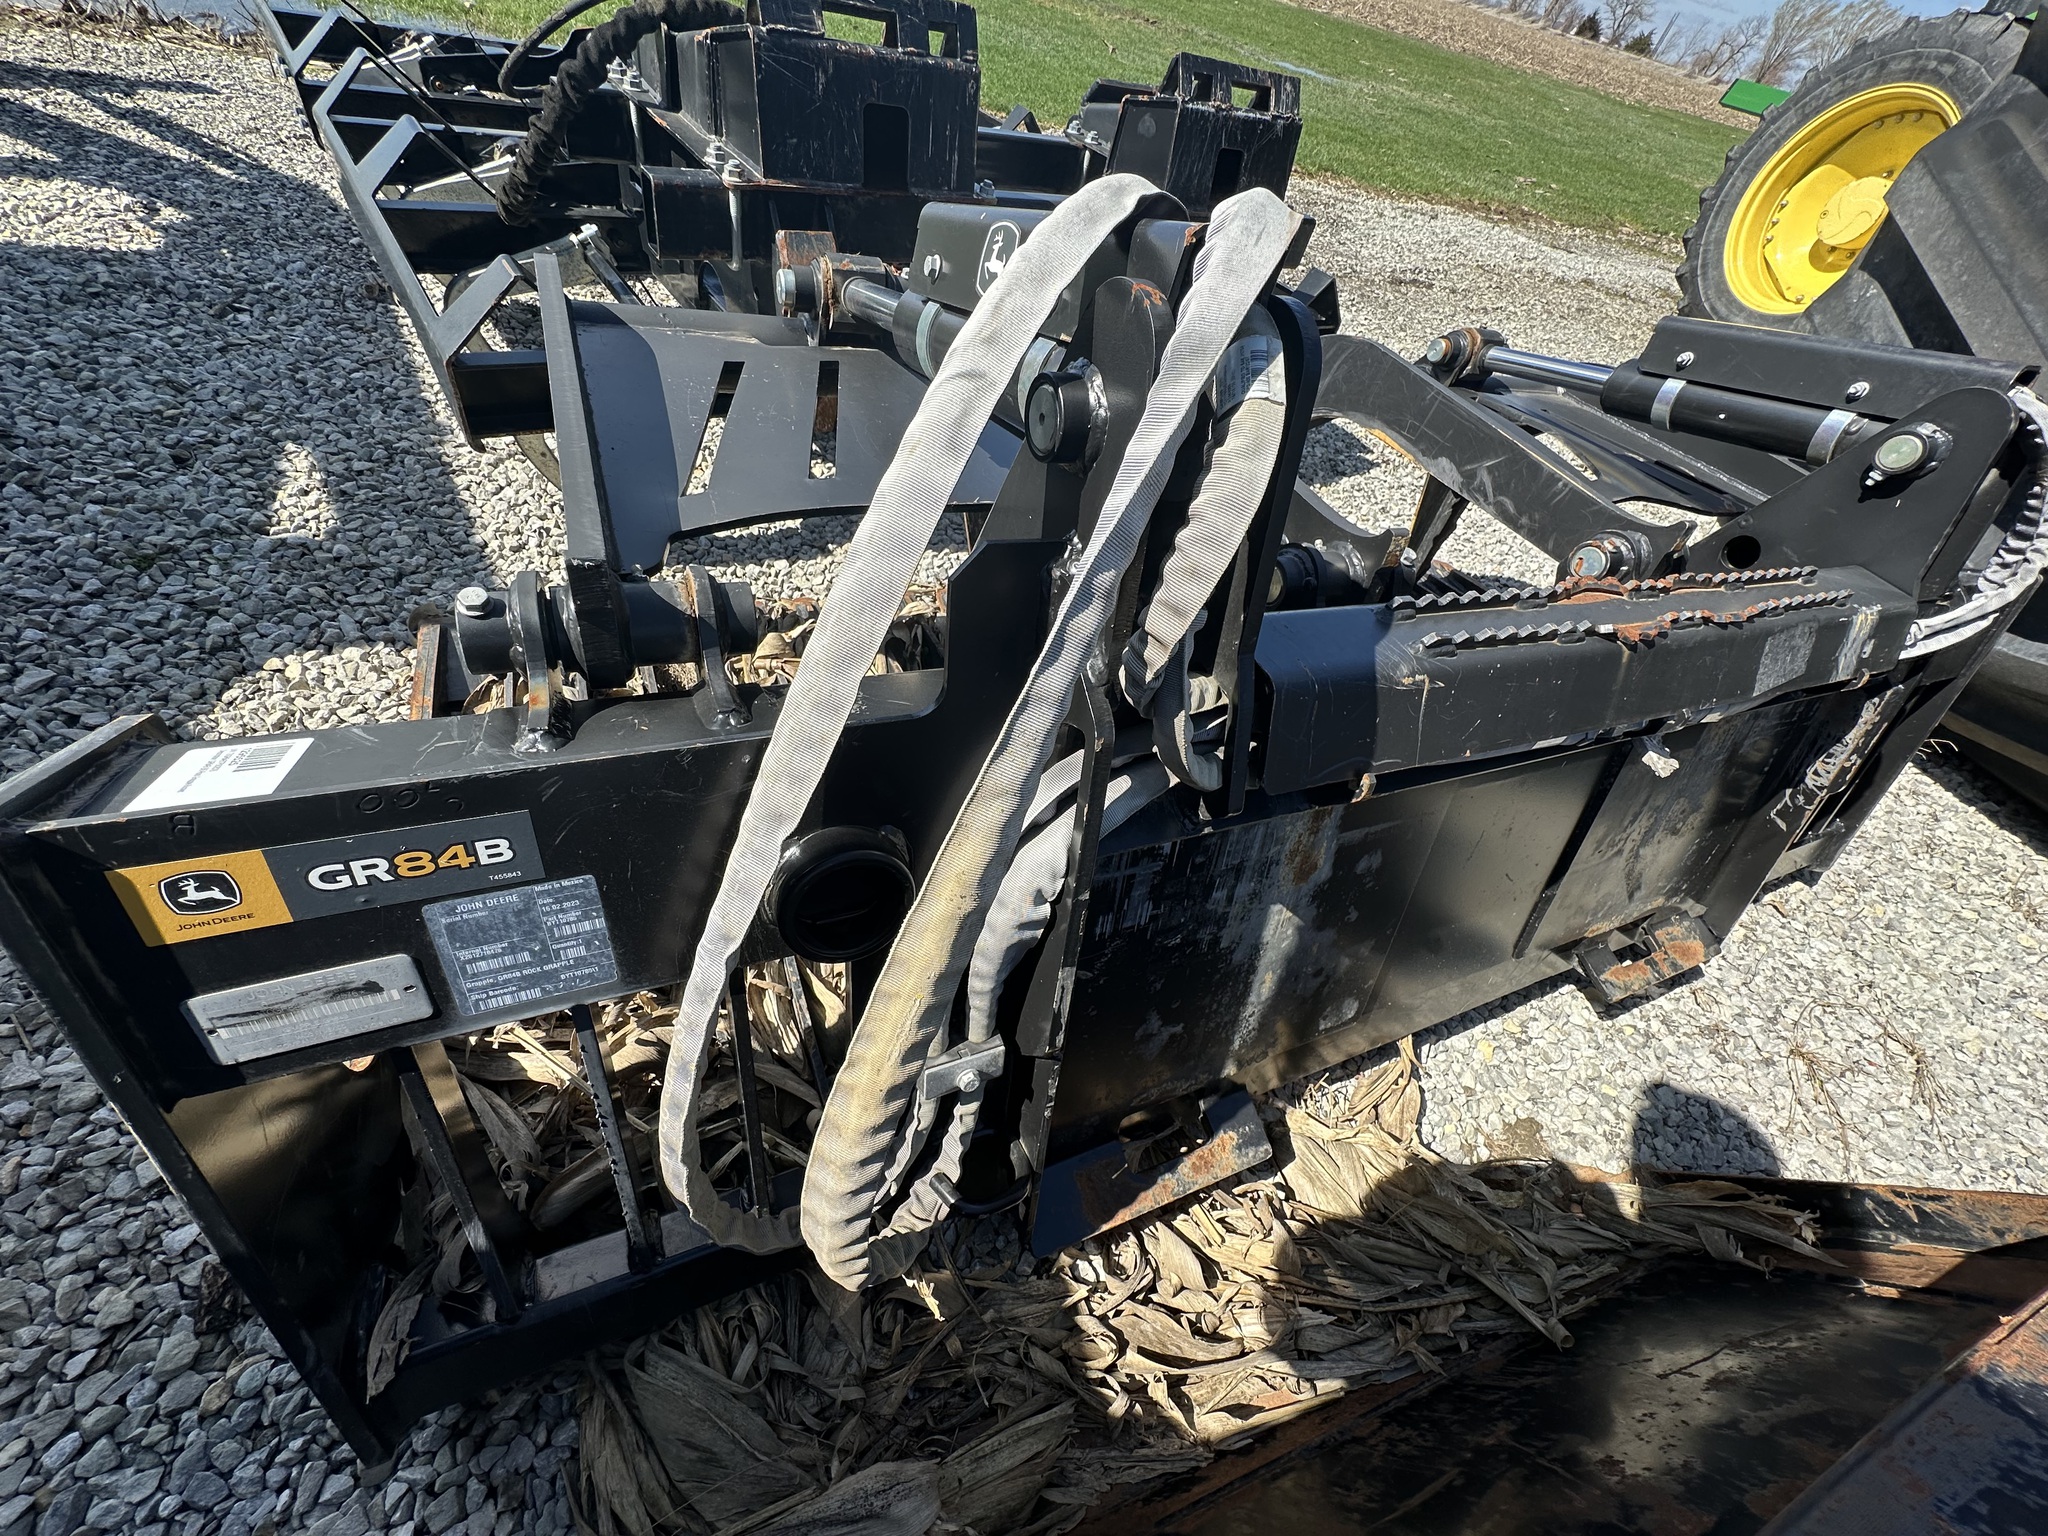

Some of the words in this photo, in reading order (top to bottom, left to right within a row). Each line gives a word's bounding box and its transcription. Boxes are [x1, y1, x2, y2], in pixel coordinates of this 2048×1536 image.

[306, 838, 515, 891] GR84B
[488, 871, 522, 881] T455843
[455, 901, 483, 913] JOHN
[486, 893, 519, 907] DEERE
[538, 897, 556, 905] Date:
[176, 920, 212, 932] JOHN
[212, 912, 256, 925] DEERE
[441, 914, 462, 924] Serial
[462, 910, 489, 920] Number
[557, 910, 582, 920] Number
[455, 946, 482, 957] Internal
[482, 942, 509, 951] Number
[465, 978, 497, 988] Grapple,
[522, 966, 543, 976] ROCK
[543, 959, 575, 971] GRAPPLE
[247, 984, 295, 1000] JOHN
[470, 992, 488, 1001] Ship
[488, 985, 520, 997] Barcode:
